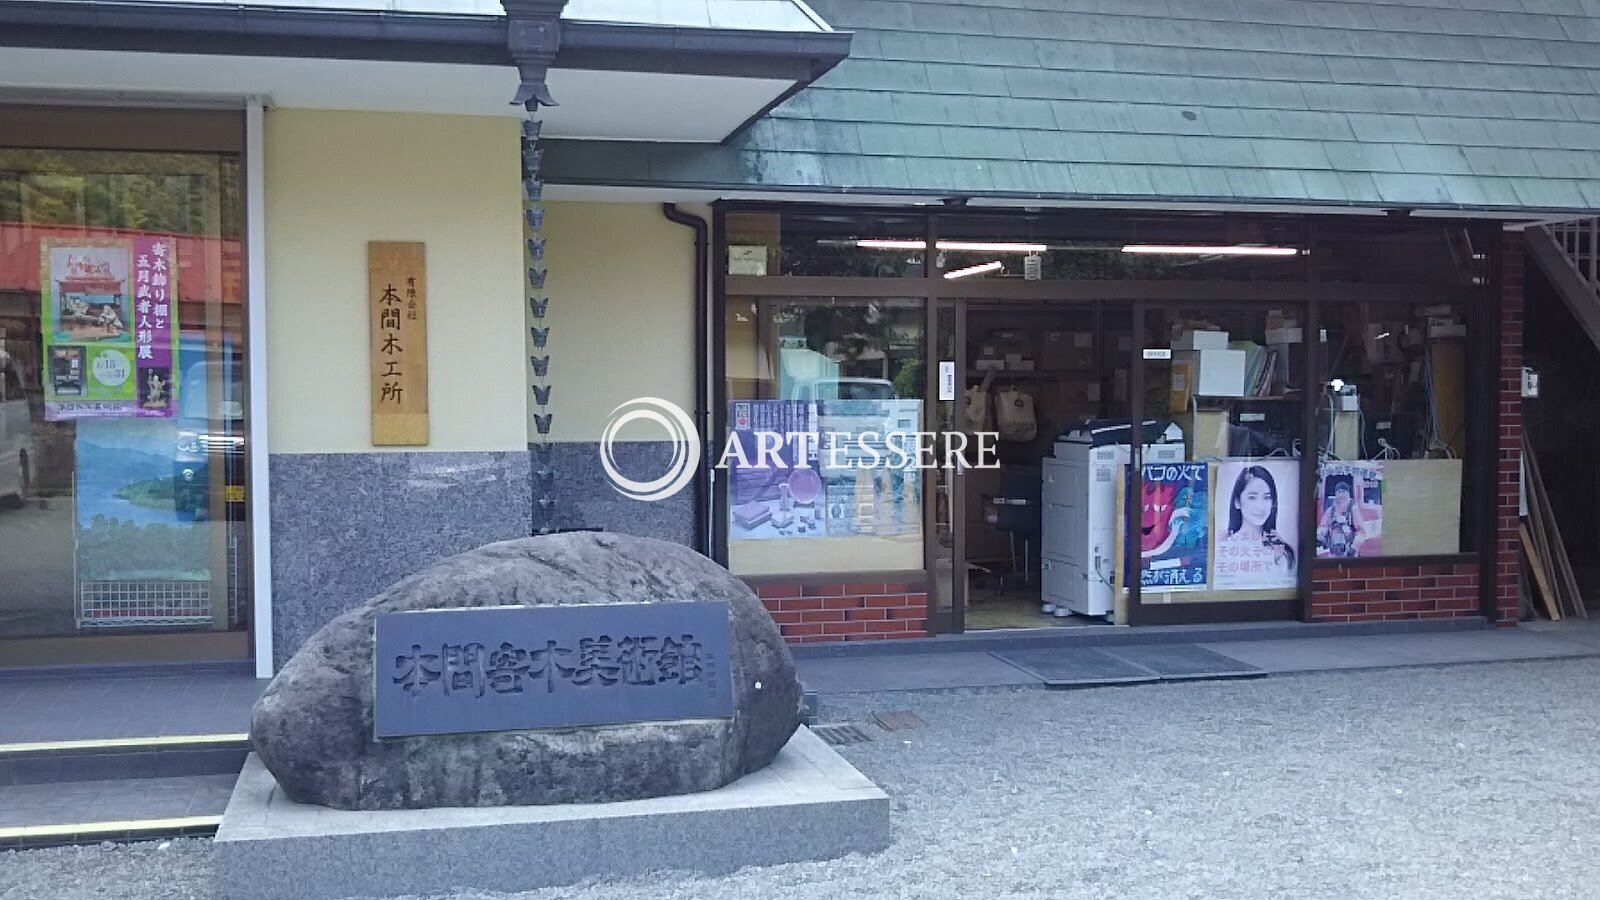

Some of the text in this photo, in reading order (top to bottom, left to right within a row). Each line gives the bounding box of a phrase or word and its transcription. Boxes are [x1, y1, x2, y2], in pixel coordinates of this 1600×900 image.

[137, 253, 154, 360] 五月武者人形展
[152, 242, 168, 329] 寄木飾り棚と
[406, 276, 417, 320] 有限会社
[379, 283, 403, 404] 本間木工所
[1141, 465, 1206, 482] バコの火で
[1141, 567, 1204, 585] 然が消える
[392, 634, 702, 698] 本間寄木美術館
